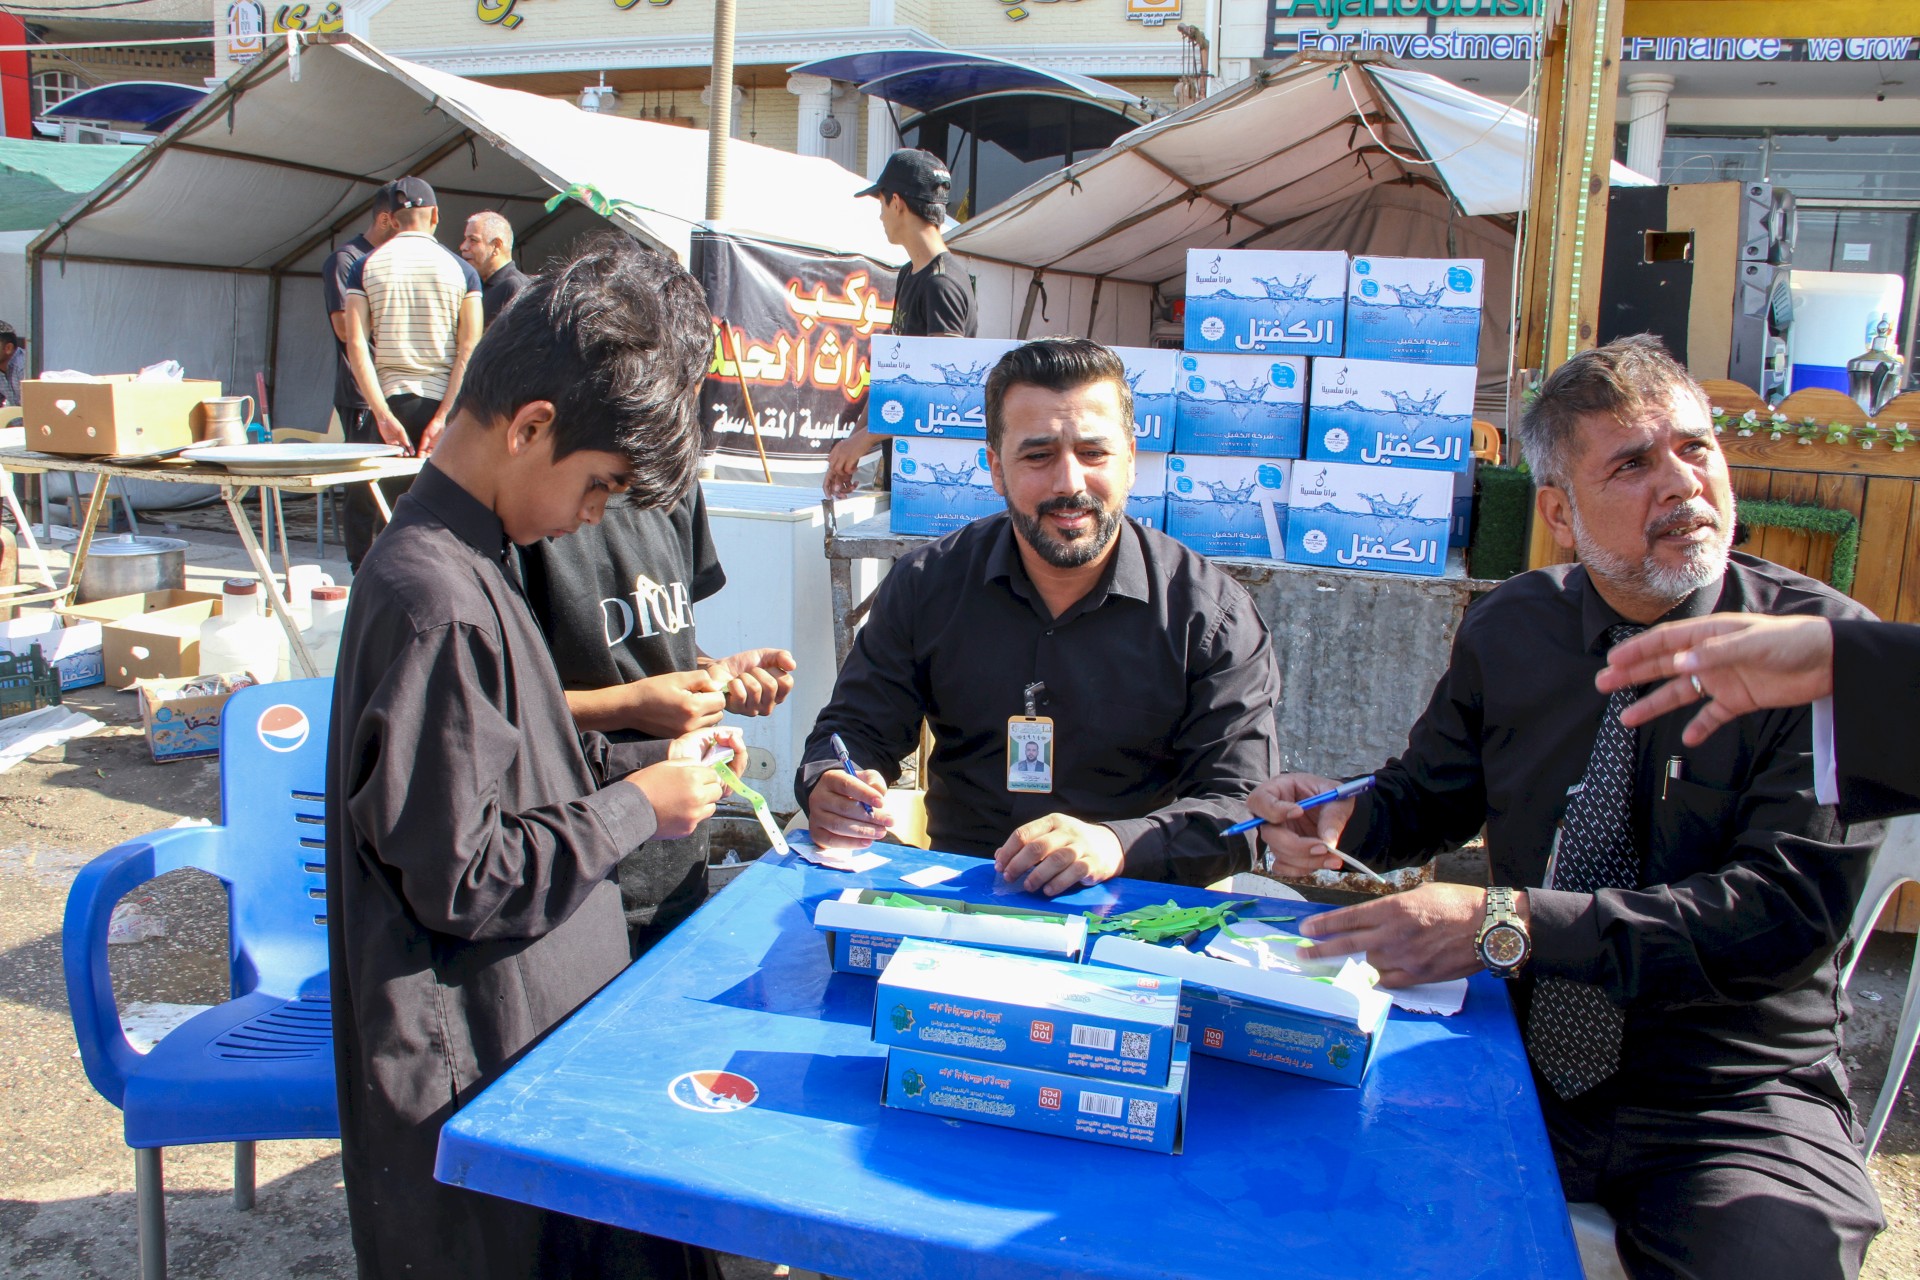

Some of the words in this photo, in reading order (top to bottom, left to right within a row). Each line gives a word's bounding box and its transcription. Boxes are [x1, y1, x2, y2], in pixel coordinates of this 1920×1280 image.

[1297, 28, 1355, 52] For
[1631, 37, 1781, 61] Finance
[1845, 37, 1912, 60] Grow
[789, 275, 894, 335] وكب
[1235, 318, 1334, 350] الكفيل
[712, 403, 795, 439] المقدسة
[914, 402, 987, 434] كفيل
[1360, 431, 1462, 465] الكفيل
[1336, 533, 1437, 566] الكفيل
[1033, 1030, 1050, 1040] 100
[1034, 1023, 1050, 1031] PCS
[1206, 1030, 1221, 1040] 100
[1206, 1038, 1220, 1046] PCS
[1041, 1096, 1058, 1107] 100
[1042, 1089, 1058, 1098] PCS
